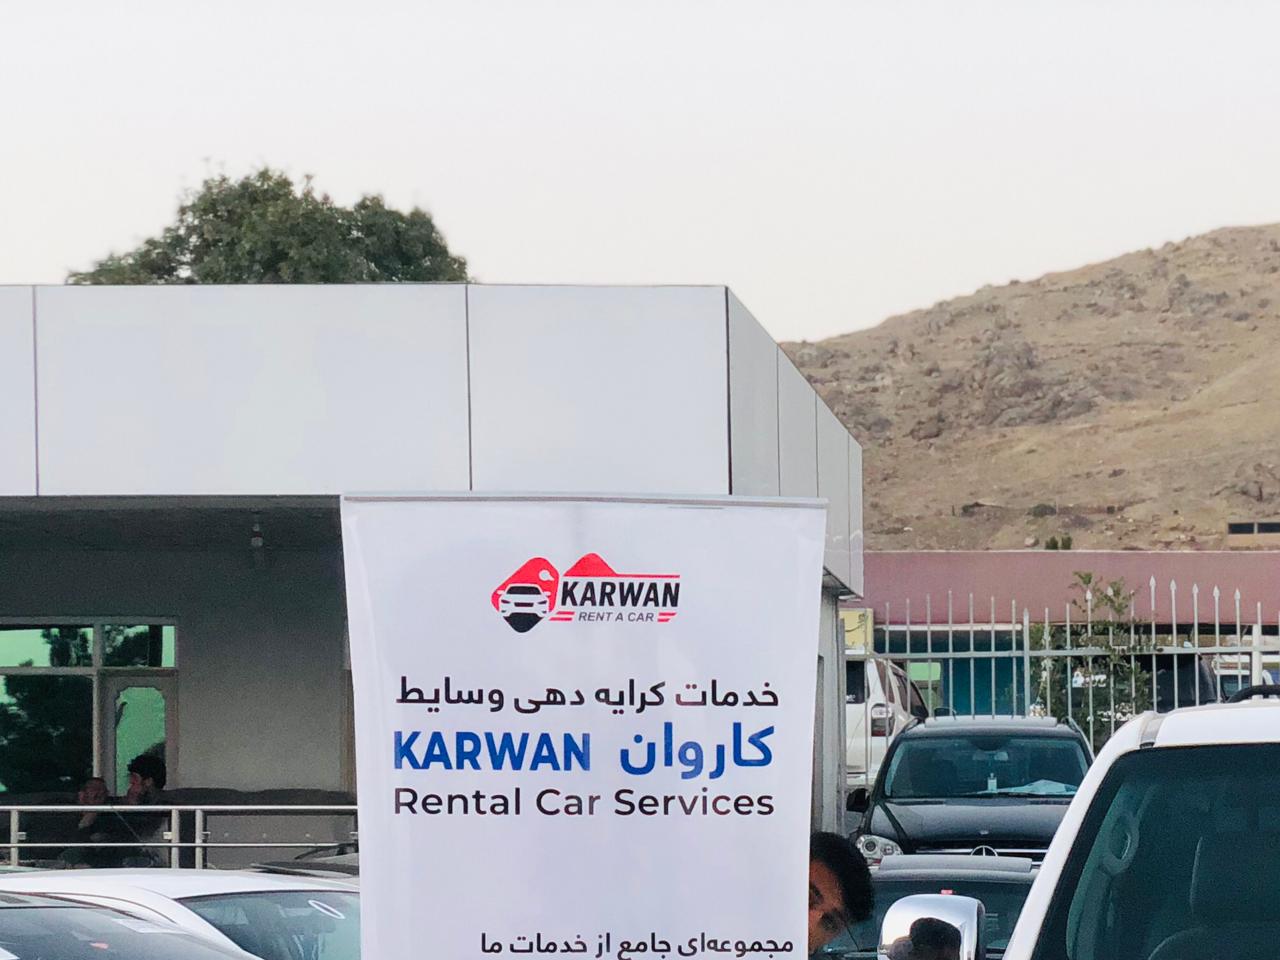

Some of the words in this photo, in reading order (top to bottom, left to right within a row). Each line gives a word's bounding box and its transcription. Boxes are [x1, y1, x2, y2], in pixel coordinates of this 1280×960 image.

[561, 581, 680, 608] KARWAN
[578, 612, 613, 622] RENT
[615, 612, 625, 622] A
[627, 611, 654, 622] CAR
[395, 676, 504, 714] وسایط
[514, 686, 585, 714] دهی
[594, 679, 666, 714] کرایه
[676, 680, 779, 707] خدمات
[394, 731, 590, 771] KARWAN
[619, 722, 775, 780] کاروان
[394, 787, 521, 816] Rental
[536, 789, 600, 816] Car
[614, 788, 774, 816] Services
[481, 932, 502, 954] ما
[509, 933, 587, 954] خدمات
[595, 932, 611, 958] از
